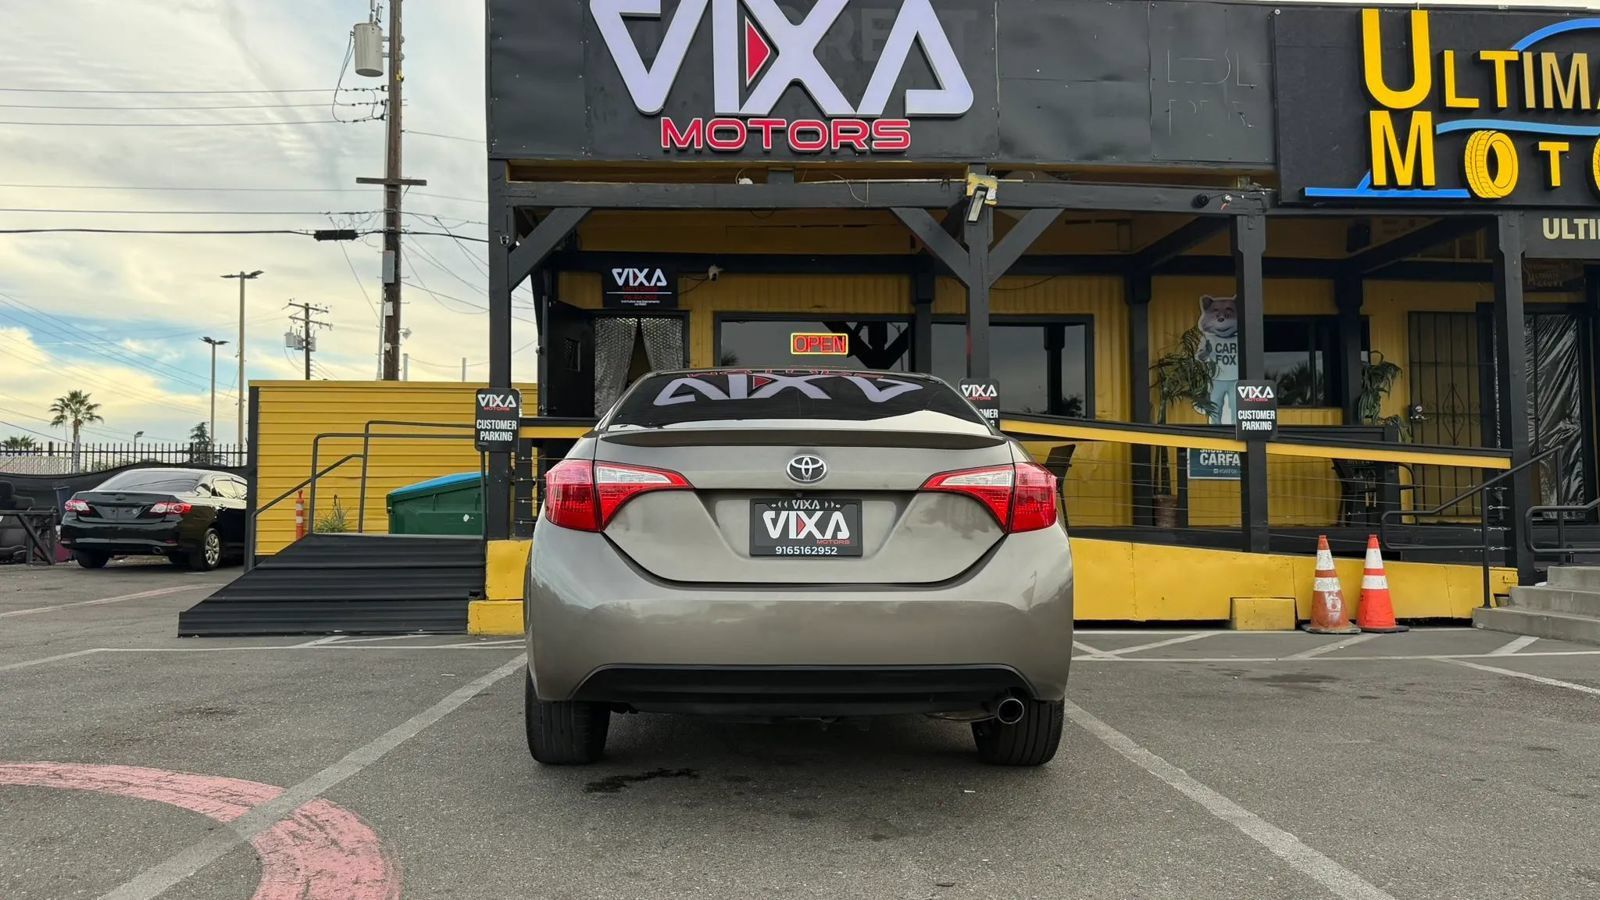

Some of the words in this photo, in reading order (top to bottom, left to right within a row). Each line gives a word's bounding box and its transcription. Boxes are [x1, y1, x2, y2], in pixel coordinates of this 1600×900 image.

[590, 0, 974, 118] VIXA
[1362, 8, 1600, 110] ULTIM
[660, 116, 911, 153] MOTORS
[1370, 110, 1600, 199] MOT
[1543, 217, 1600, 240] ULTI
[611, 268, 667, 287] VIXA
[794, 335, 846, 353] OPEN
[1215, 342, 1236, 354] CAR
[1216, 354, 1237, 365] FOX
[961, 384, 998, 397] VIXA
[1237, 386, 1274, 399] VIXA
[477, 394, 517, 408] VIXA
[1237, 410, 1275, 420] CUSTOMER
[476, 420, 517, 430] CUSTOMER
[1242, 421, 1272, 431] PARKING
[480, 431, 513, 442] PARKING
[792, 500, 820, 510] VIXA
[762, 511, 850, 540] VIXA
[775, 546, 838, 555] 9165162952
